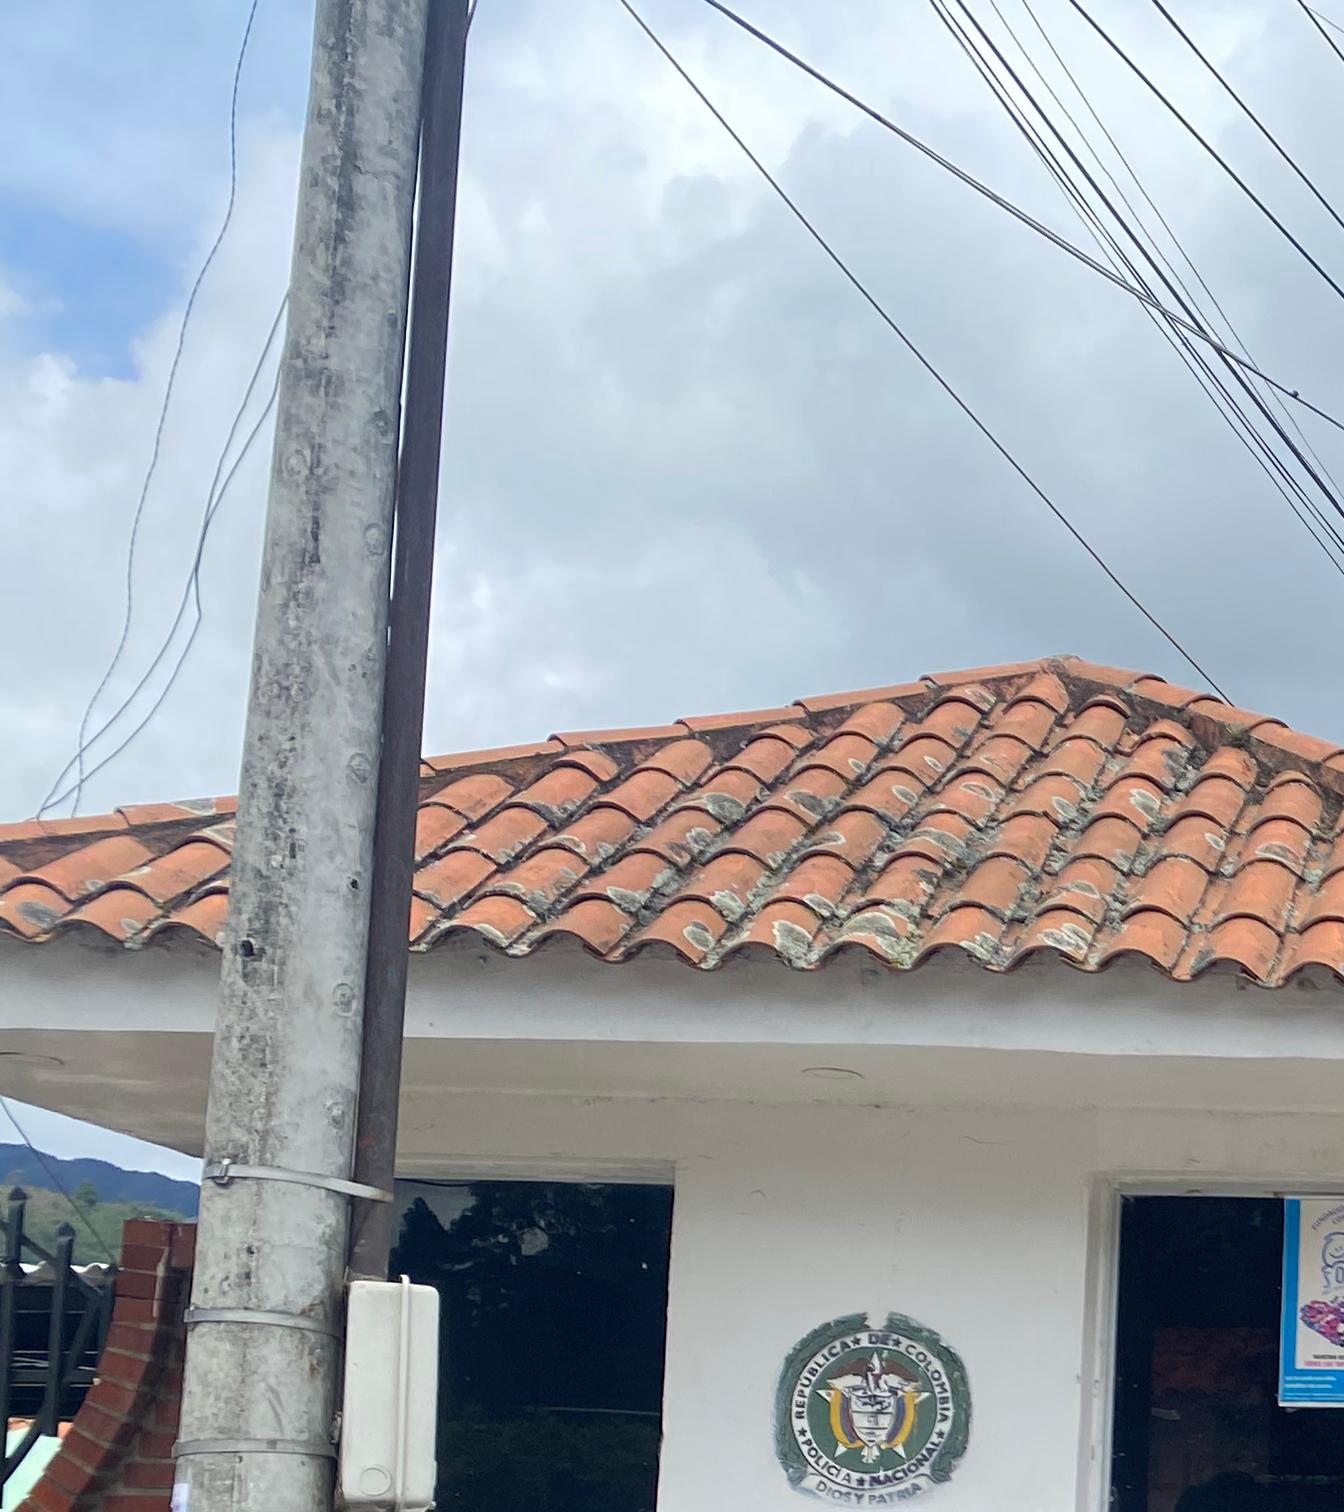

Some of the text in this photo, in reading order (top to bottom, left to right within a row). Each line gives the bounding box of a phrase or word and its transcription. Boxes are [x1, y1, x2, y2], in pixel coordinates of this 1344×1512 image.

[868, 1333, 893, 1345] DE
[905, 1344, 950, 1423] COLOMBIA
[869, 1439, 944, 1487] NACIONAL
[815, 1479, 851, 1500] DIOS
[868, 1482, 921, 1504] PATRIA
